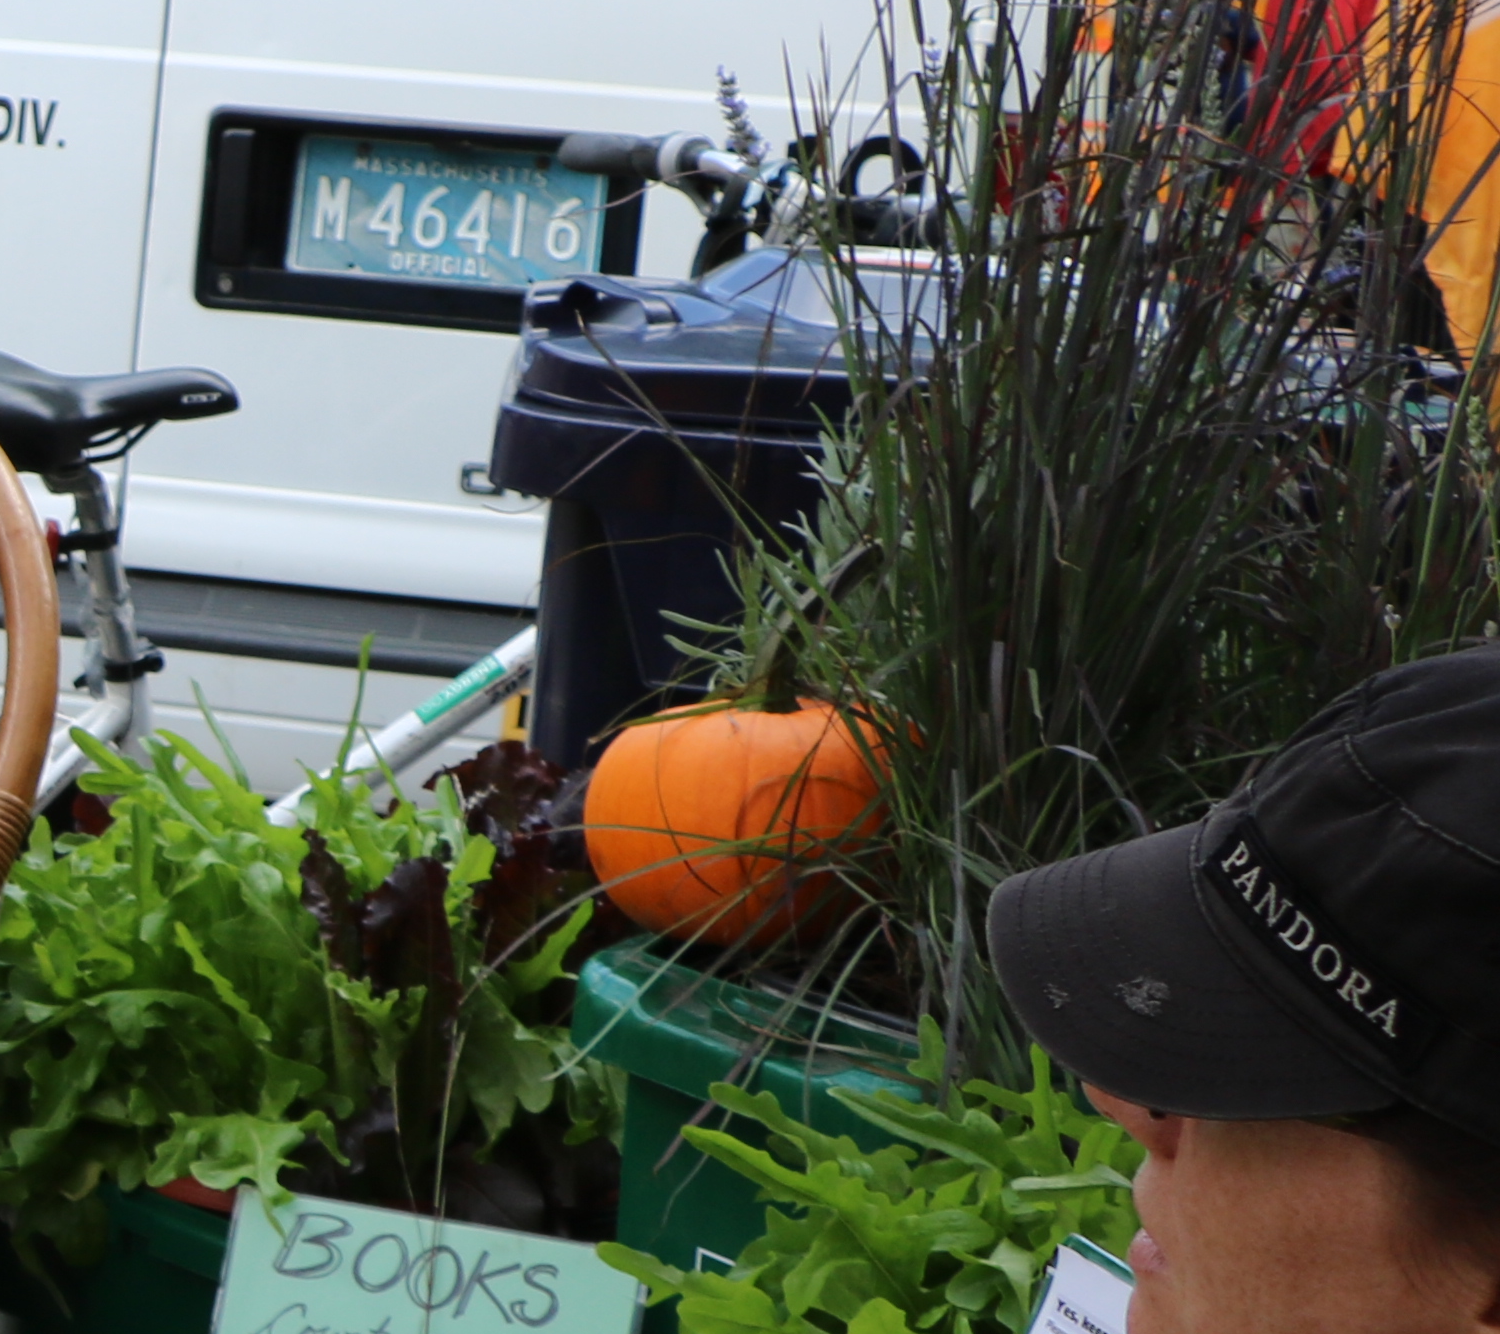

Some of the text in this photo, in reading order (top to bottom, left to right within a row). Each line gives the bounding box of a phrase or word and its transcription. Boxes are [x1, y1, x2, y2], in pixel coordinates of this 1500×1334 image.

[353, 154, 549, 188] MASSACHUSETTS
[388, 250, 491, 279] OFFICIAL
[1220, 839, 1398, 1039] PANDORA
[272, 1212, 561, 1328] BOOKS
[1055, 1297, 1079, 1325] Yes,
